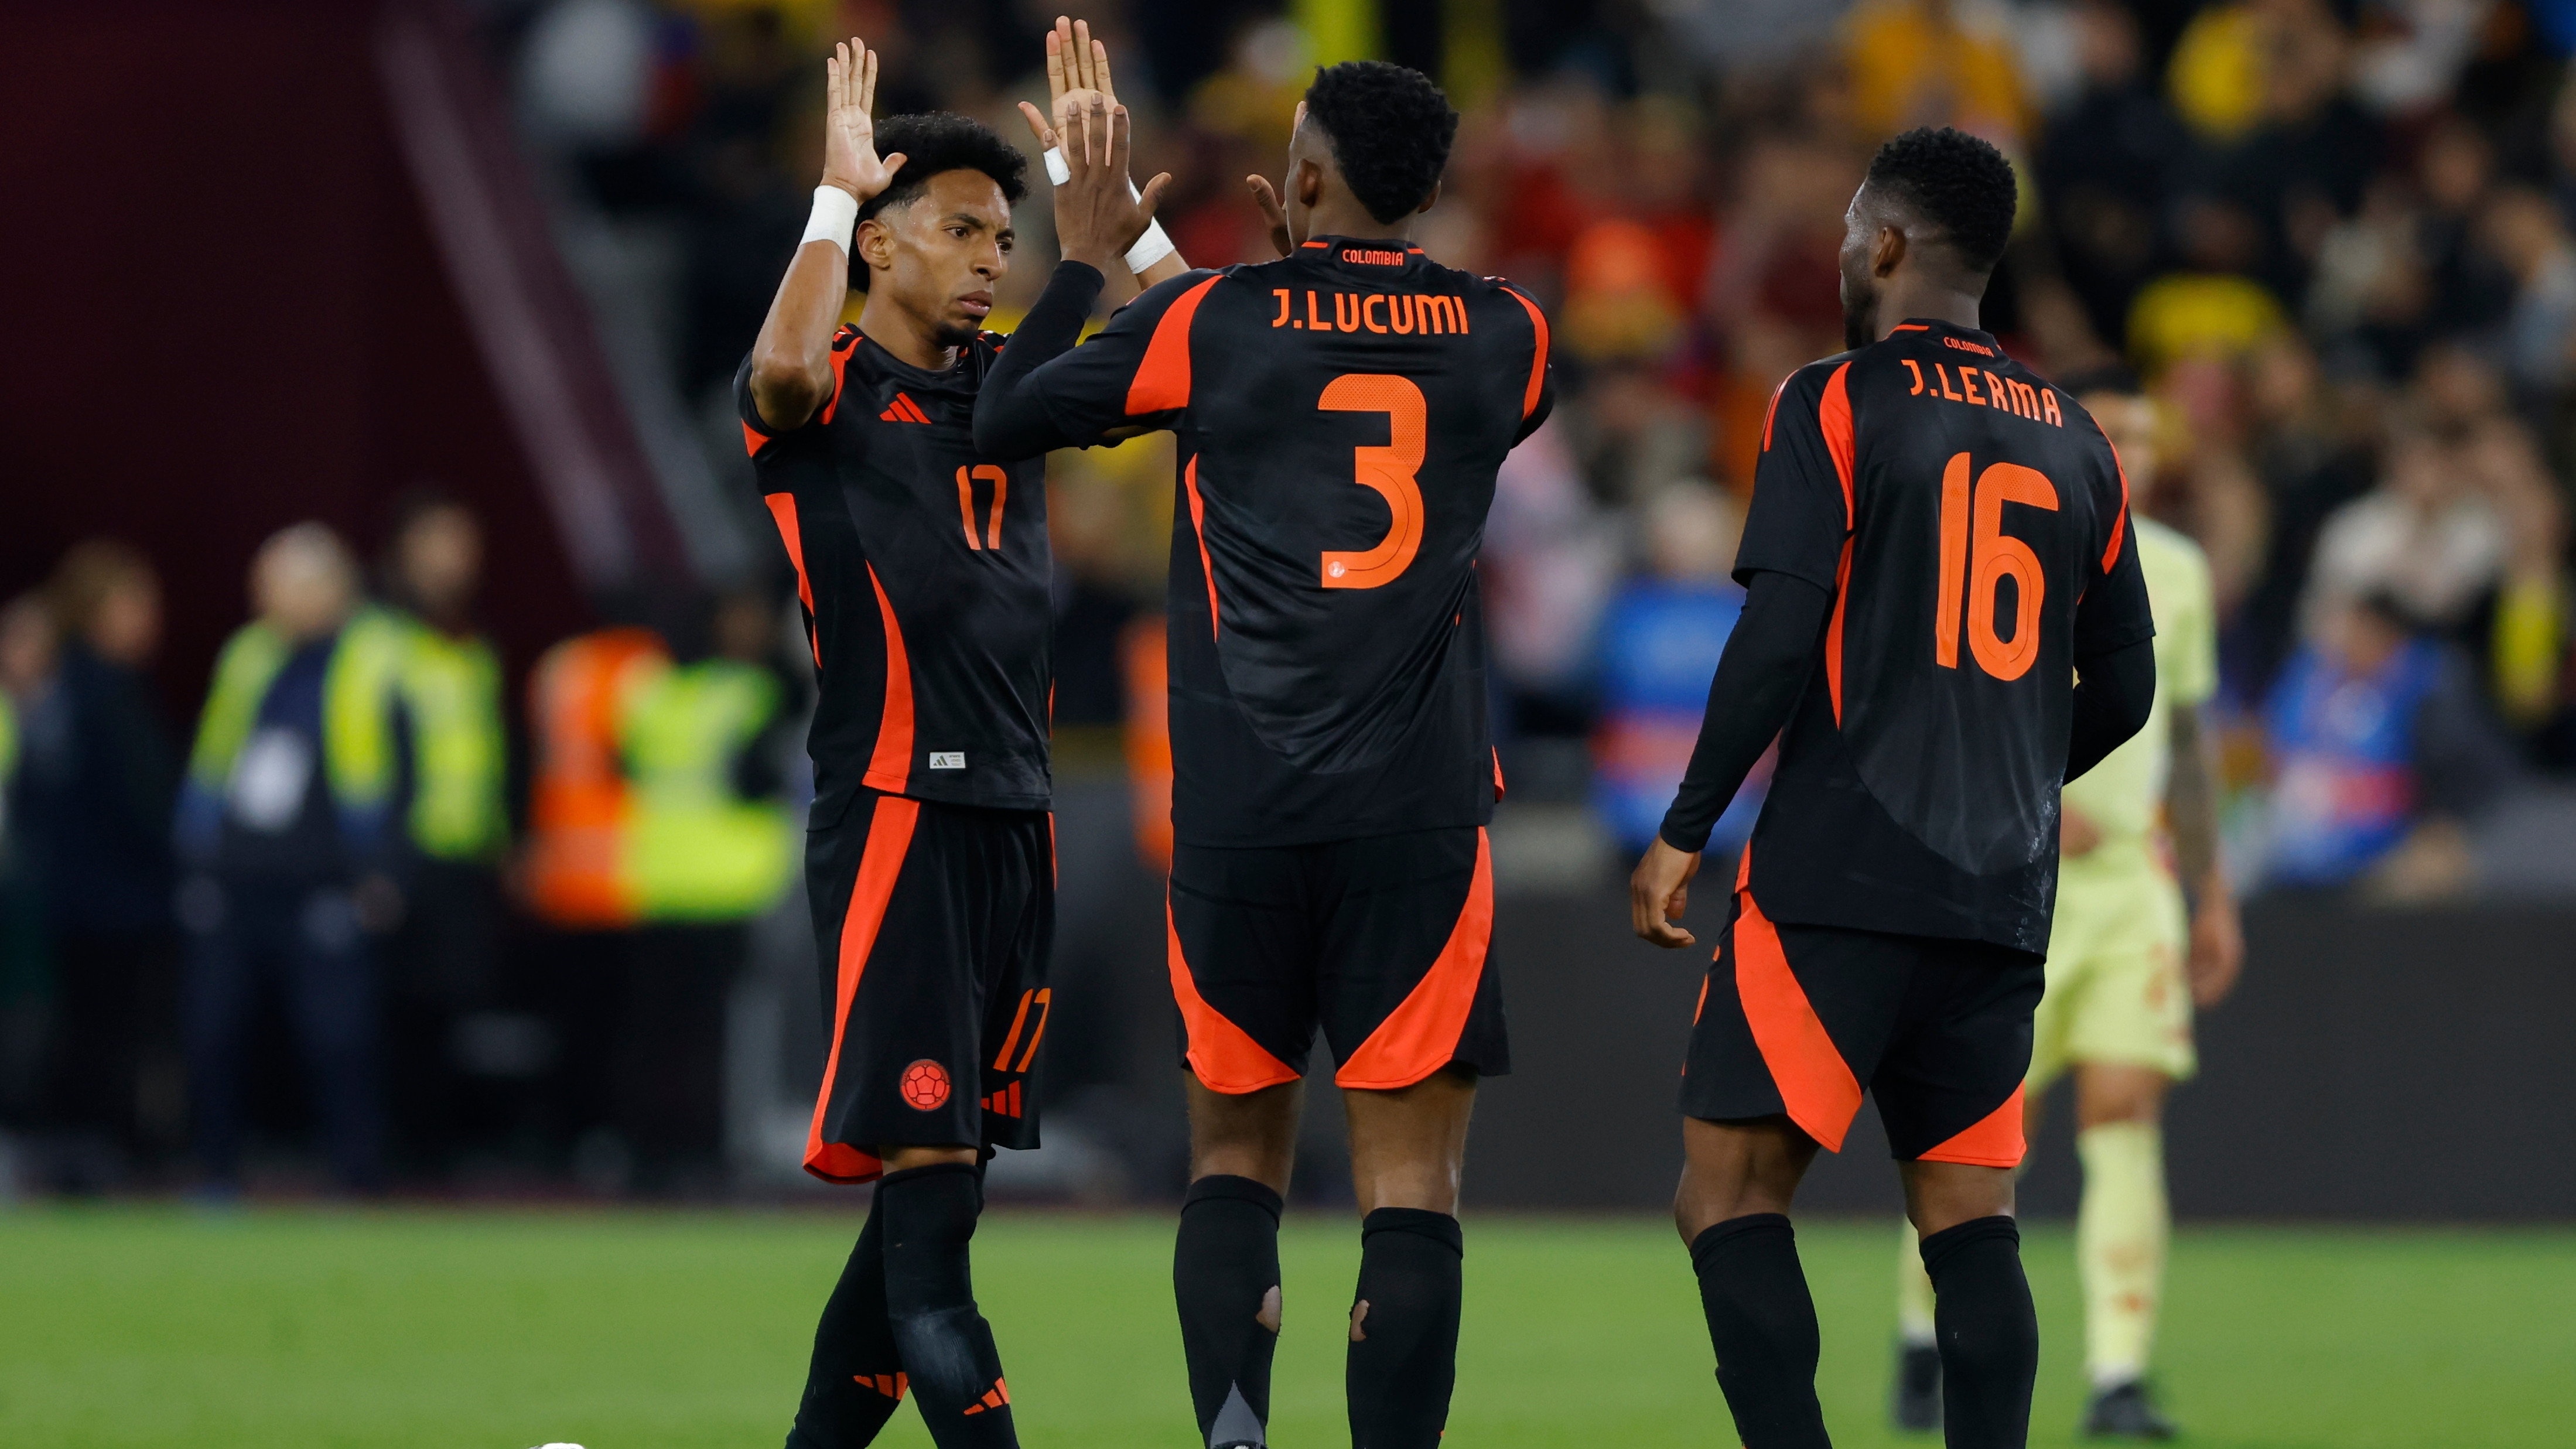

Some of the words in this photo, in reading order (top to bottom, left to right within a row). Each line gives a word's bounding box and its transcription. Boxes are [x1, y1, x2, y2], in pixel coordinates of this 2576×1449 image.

[1342, 250, 1403, 265] COLOMBIA
[1273, 289, 1468, 334] J.LUCUMI
[1944, 337, 1993, 356] COLOMBIA
[1901, 360, 2062, 426] J.LERMA
[956, 465, 1006, 550] 17
[1318, 374, 1426, 589] 3
[1936, 452, 2058, 681] 16
[994, 989, 1050, 1072] 17
